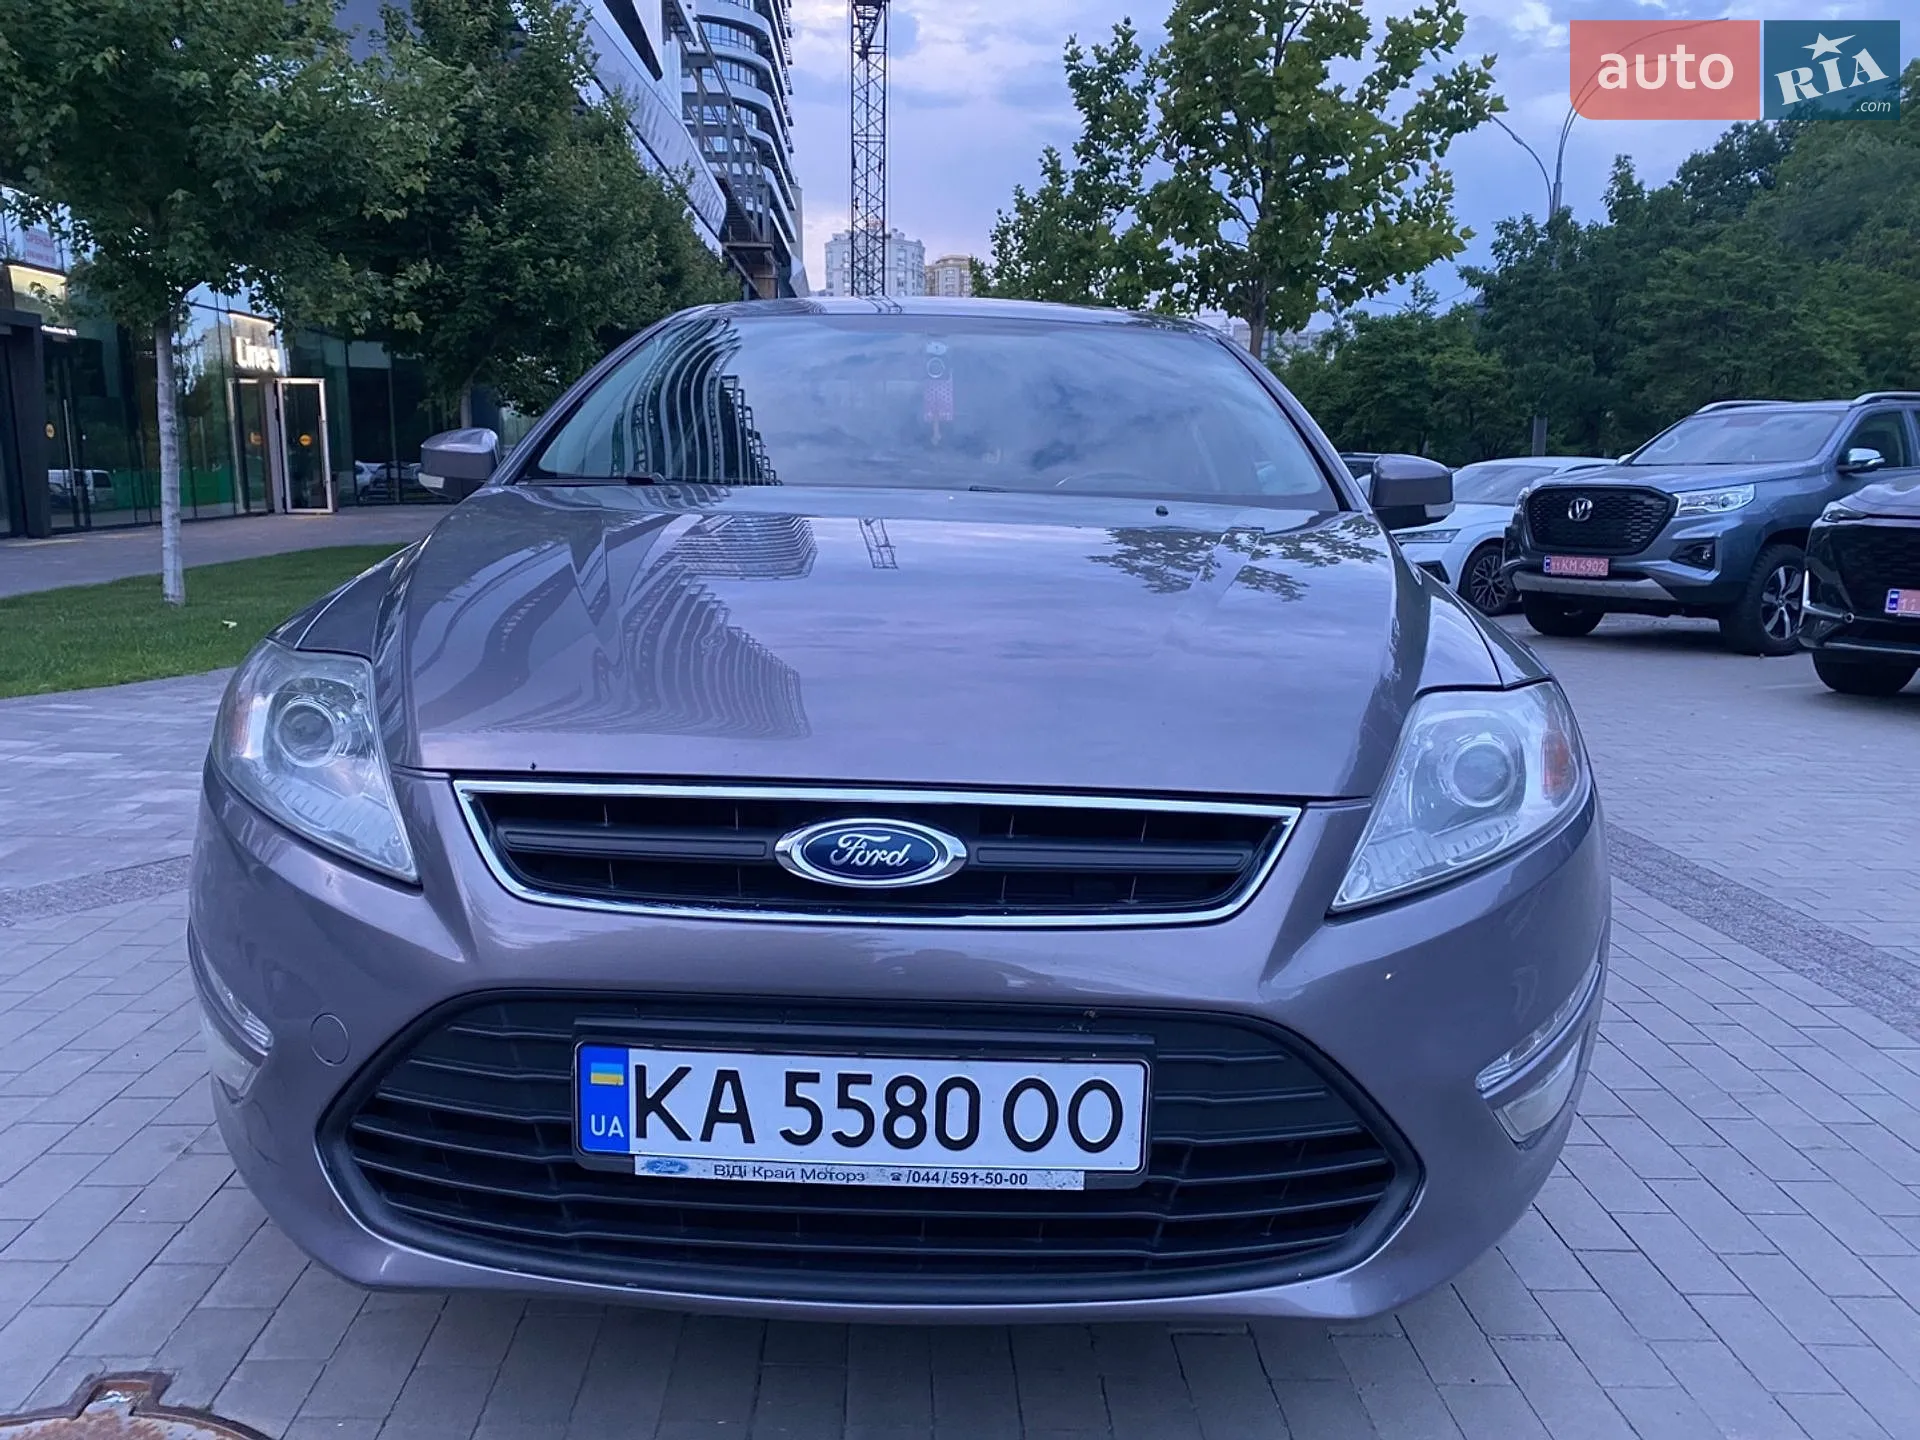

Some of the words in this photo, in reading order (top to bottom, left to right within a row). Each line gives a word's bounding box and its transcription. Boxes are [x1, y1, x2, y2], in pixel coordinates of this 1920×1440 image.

[1580, 560, 1606, 573] 4902
[829, 832, 911, 867] Ford
[634, 1064, 755, 1144] KA
[780, 1071, 981, 1151] 5580
[1002, 1077, 1124, 1153] OO
[591, 1114, 624, 1138] UA
[752, 1166, 795, 1181] Край
[801, 1167, 866, 1183] Моторз
